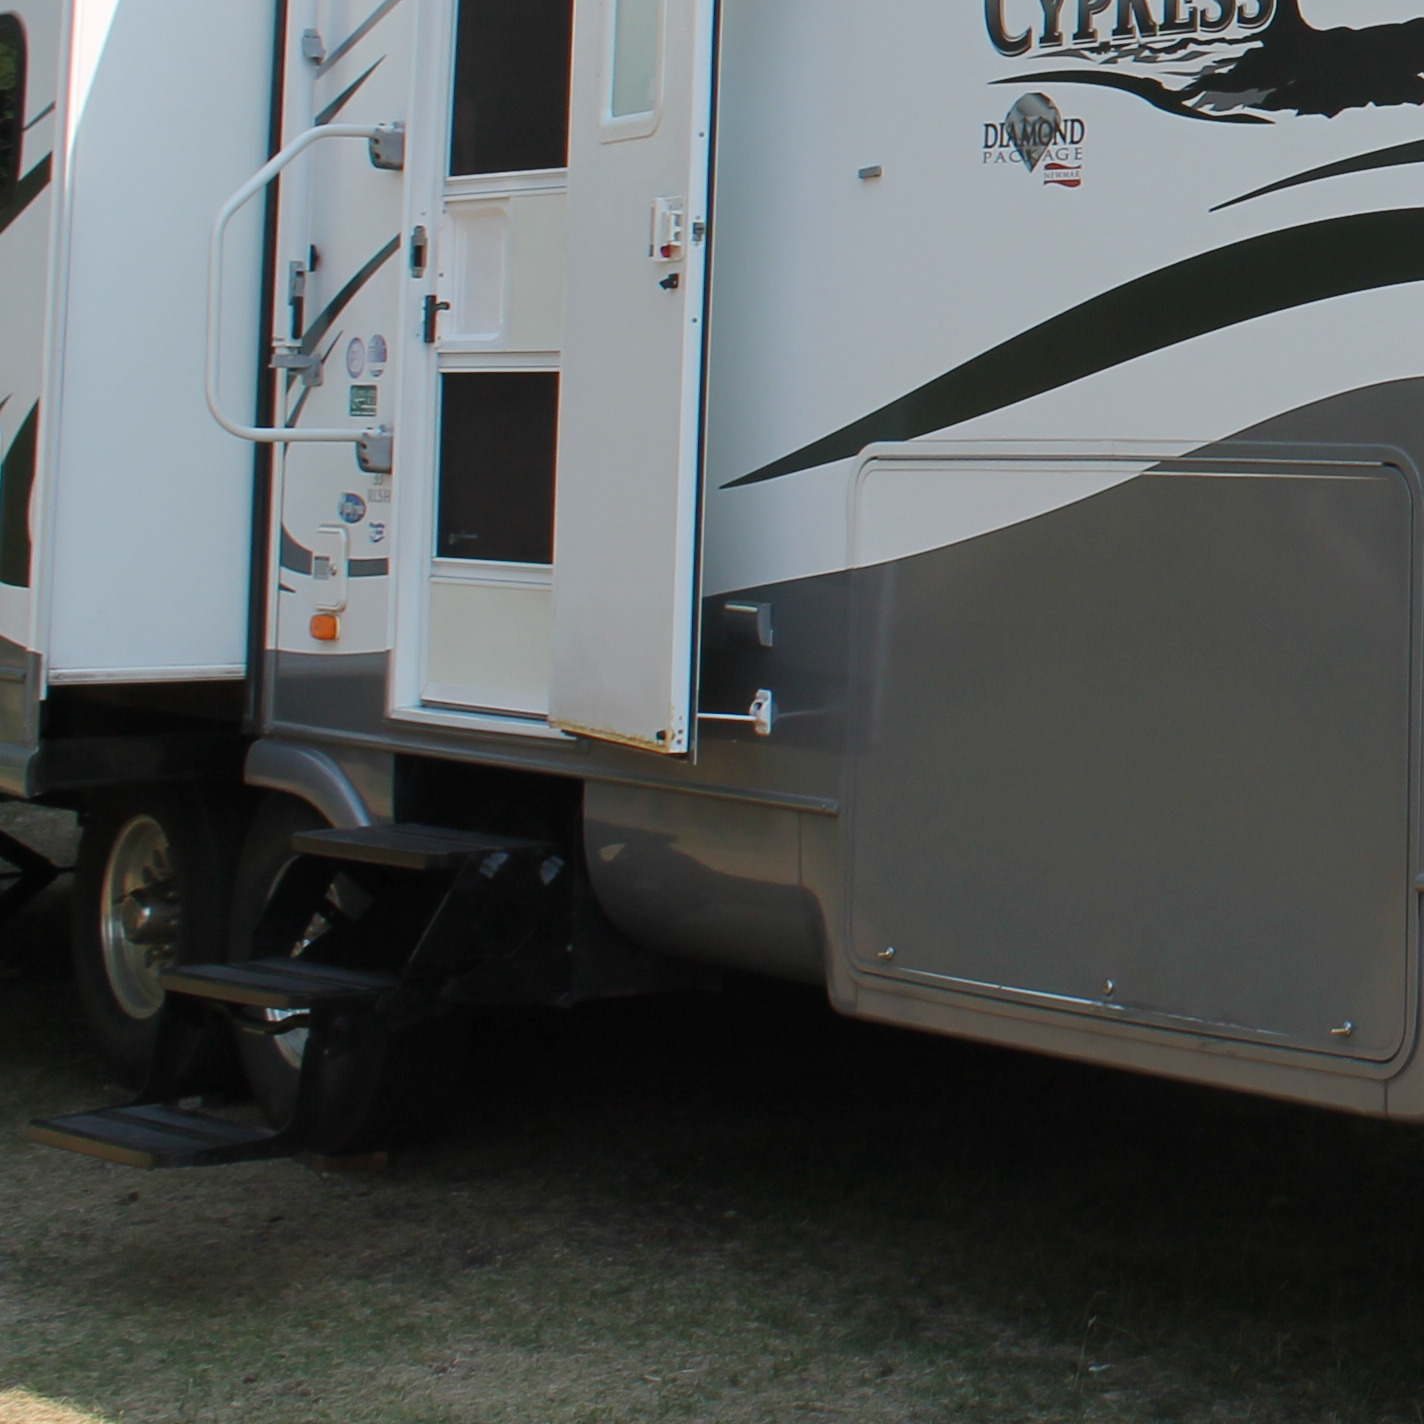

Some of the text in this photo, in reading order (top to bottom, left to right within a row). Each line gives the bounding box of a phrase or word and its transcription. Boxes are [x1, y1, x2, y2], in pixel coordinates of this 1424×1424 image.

[982, 117, 1086, 149] DIAMOND
[983, 147, 1083, 164] PACKAGE
[1043, 170, 1080, 180] NEWMAR
